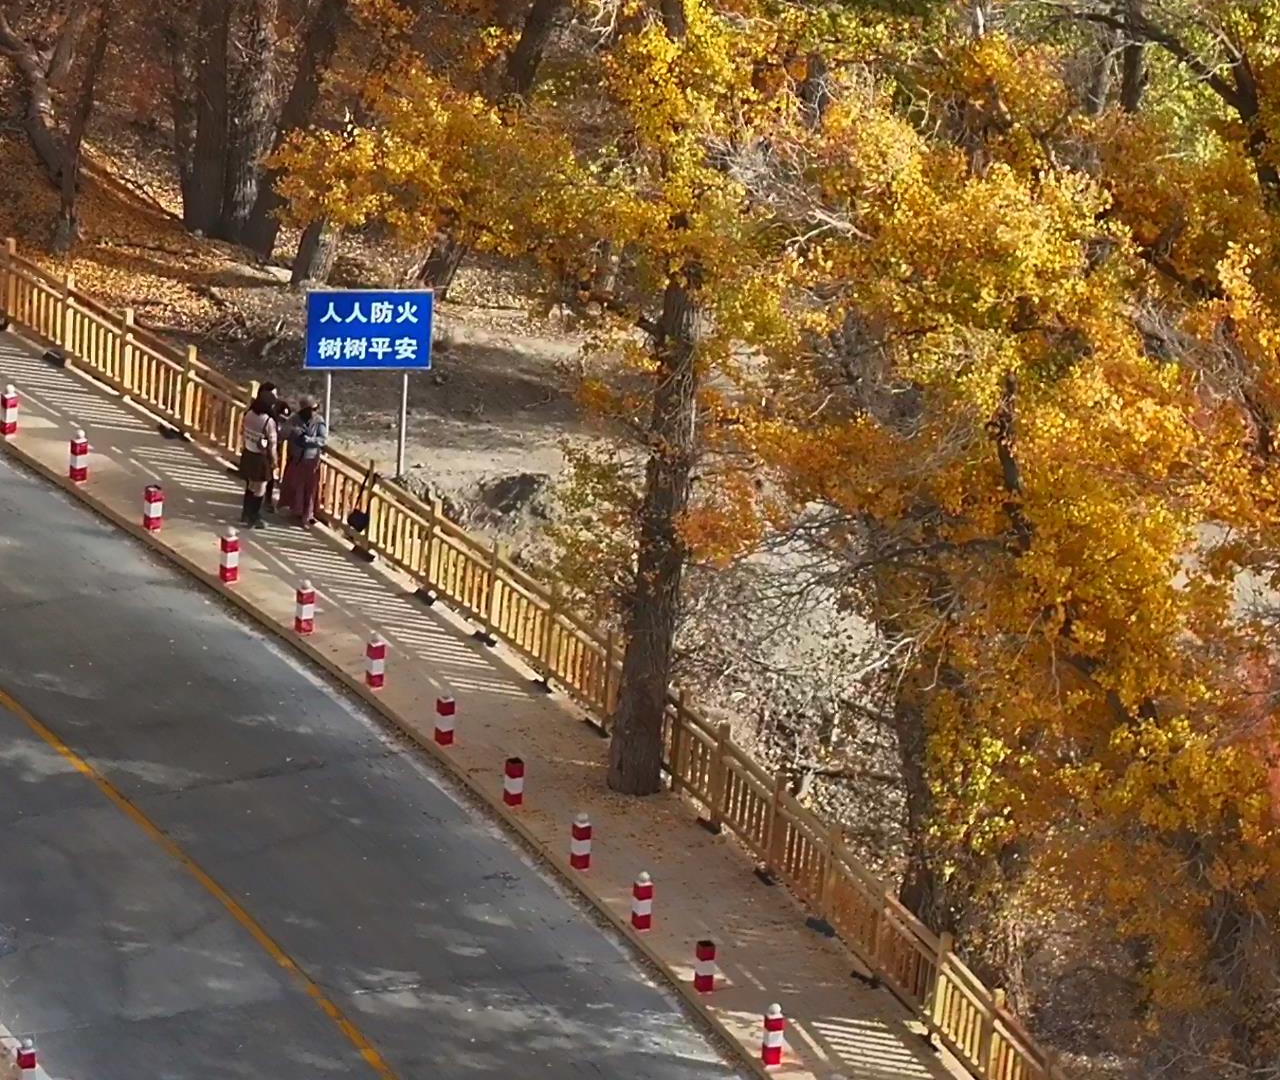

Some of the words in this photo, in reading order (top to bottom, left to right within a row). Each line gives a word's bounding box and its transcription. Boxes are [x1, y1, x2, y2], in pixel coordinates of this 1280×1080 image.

[320, 301, 418, 323] 人人防火
[318, 337, 417, 360] 树树平安
